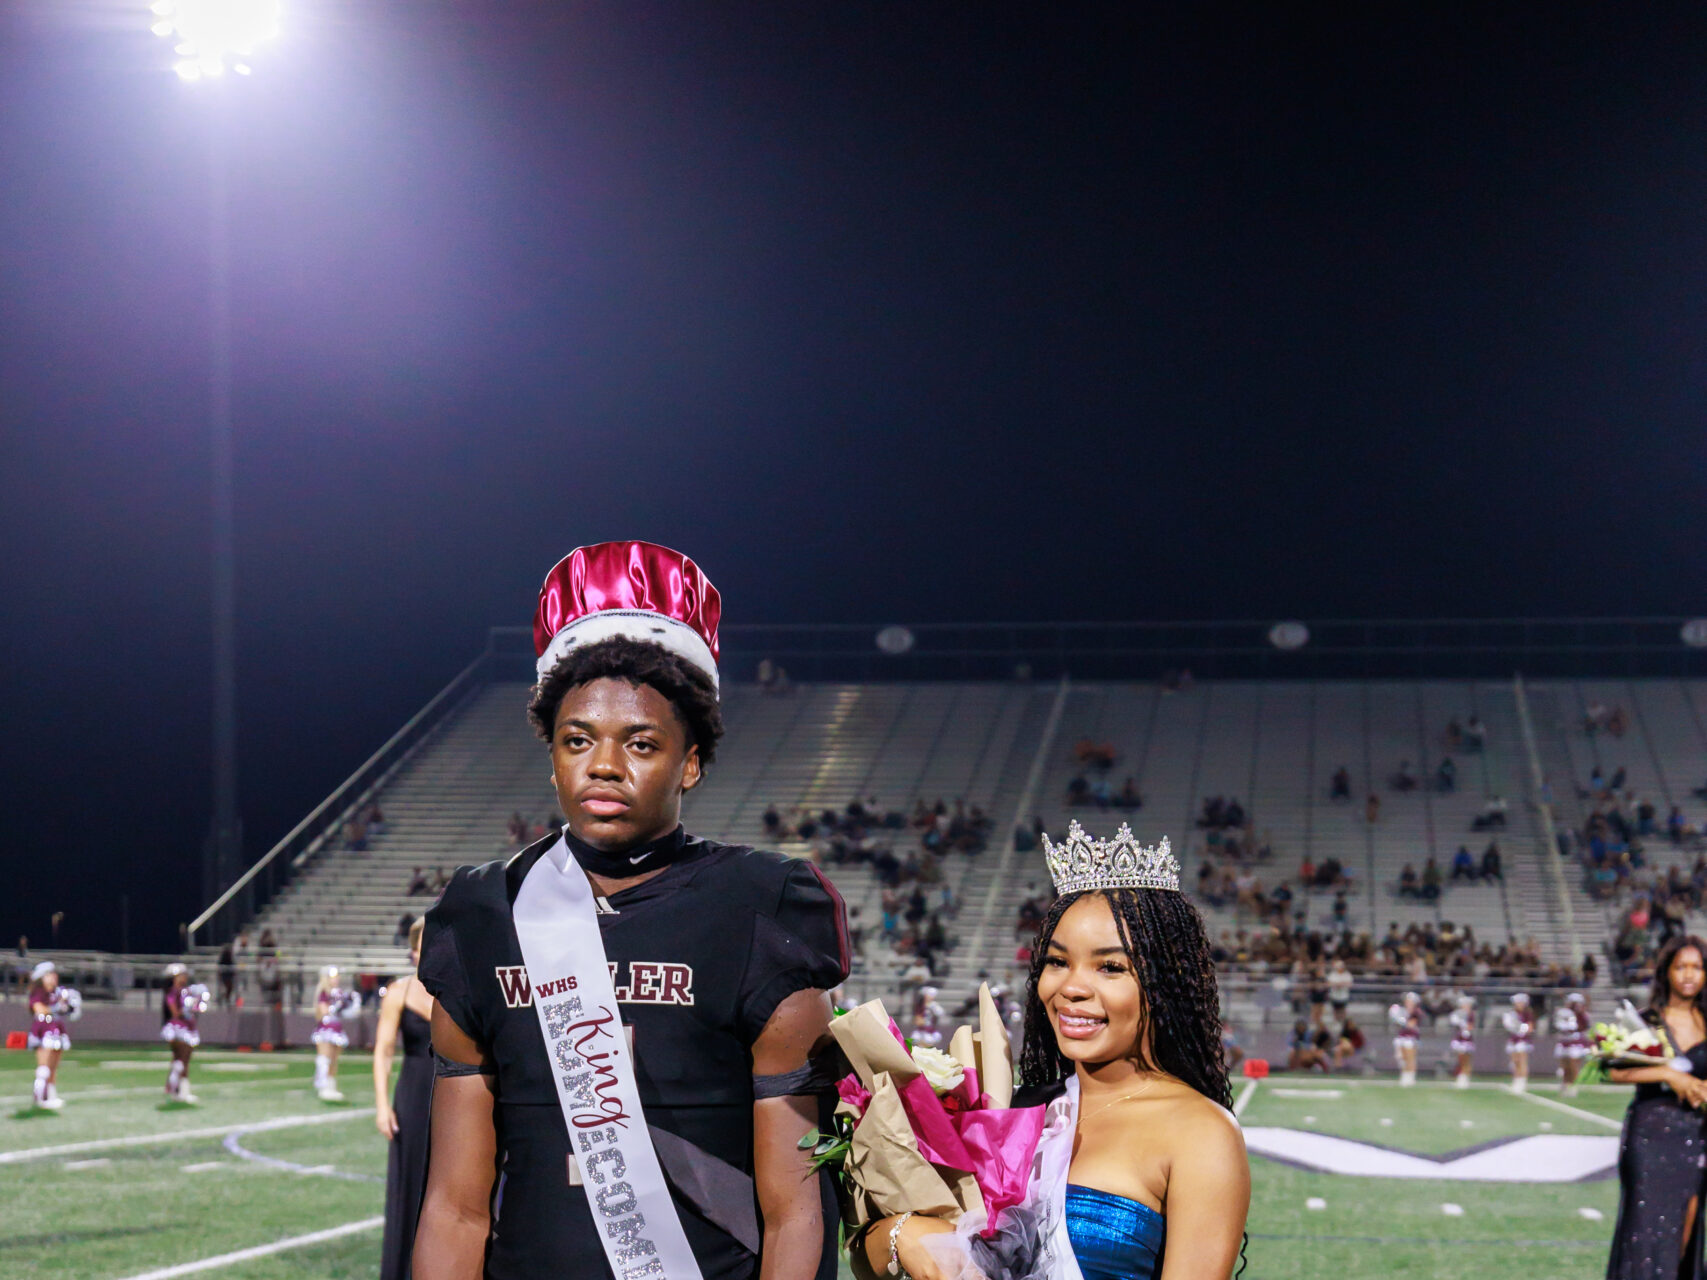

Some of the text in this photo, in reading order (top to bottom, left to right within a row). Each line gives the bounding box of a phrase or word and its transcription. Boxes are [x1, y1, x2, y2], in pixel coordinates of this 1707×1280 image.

[495, 961, 695, 1008] WLER
[535, 976, 578, 999] WHS
[566, 1005, 631, 1129] King
